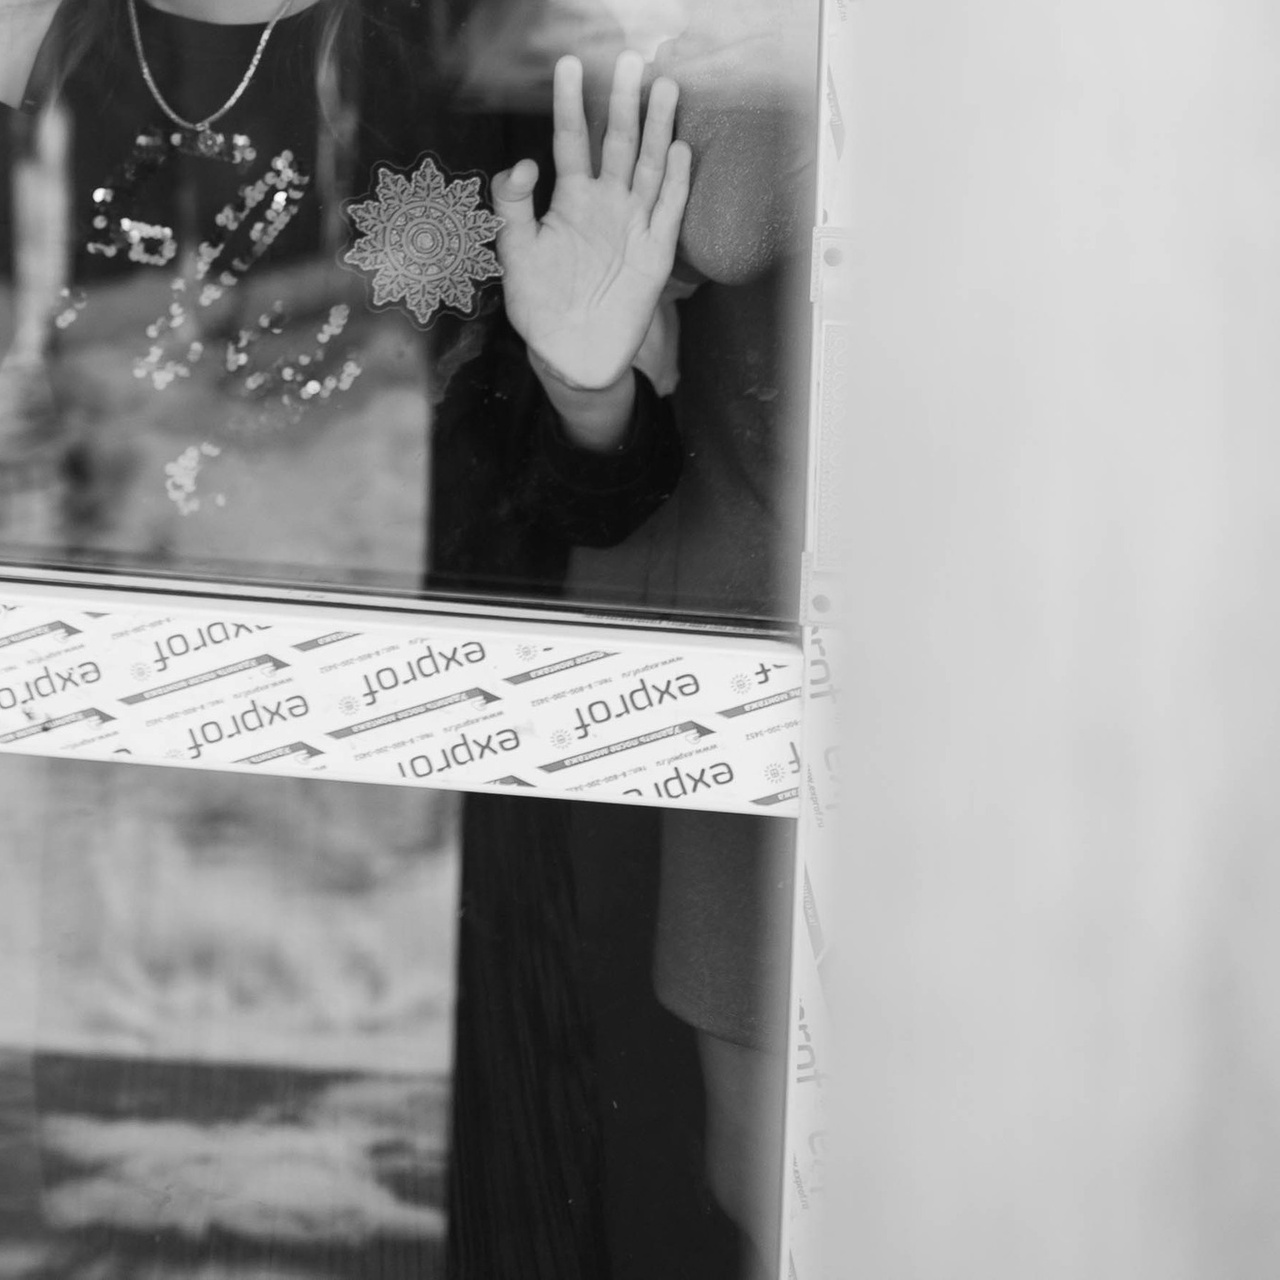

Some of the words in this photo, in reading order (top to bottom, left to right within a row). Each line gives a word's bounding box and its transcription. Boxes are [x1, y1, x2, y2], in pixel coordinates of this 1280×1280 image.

[362, 641, 487, 707] exprof
[574, 673, 700, 740] exprof
[187, 695, 310, 760] exprof
